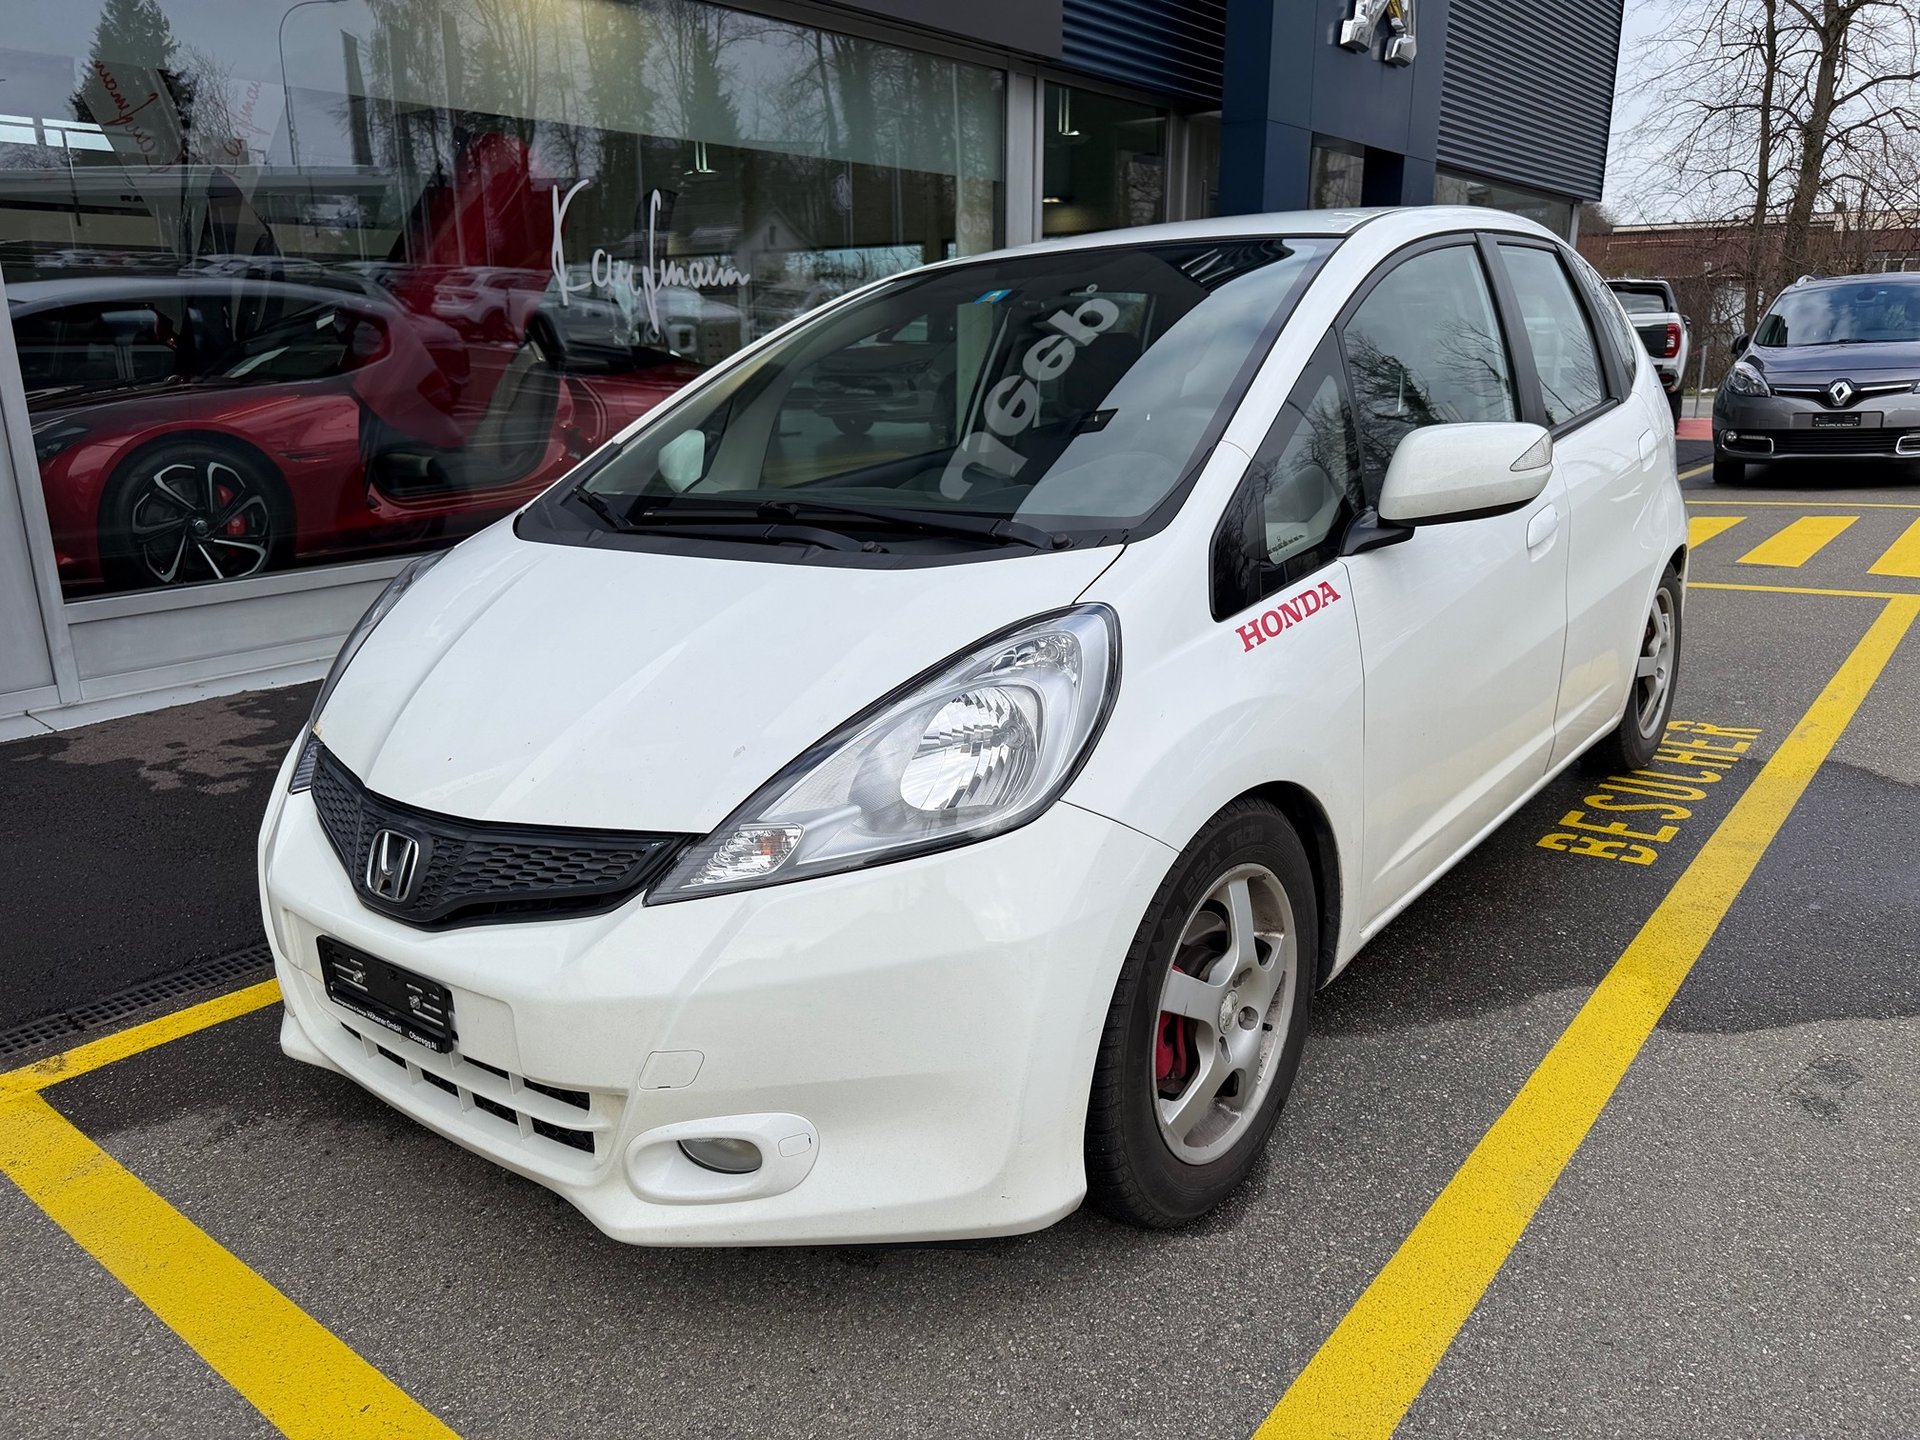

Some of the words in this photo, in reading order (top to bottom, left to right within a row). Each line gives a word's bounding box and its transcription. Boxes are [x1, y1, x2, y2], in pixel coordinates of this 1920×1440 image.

[551, 179, 750, 334] Kaufmann
[1235, 581, 1342, 653] HONDA
[1535, 720, 1763, 866] BESUCHER
[386, 1020, 402, 1034] GmbH
[408, 1030, 432, 1049] Oberegg
